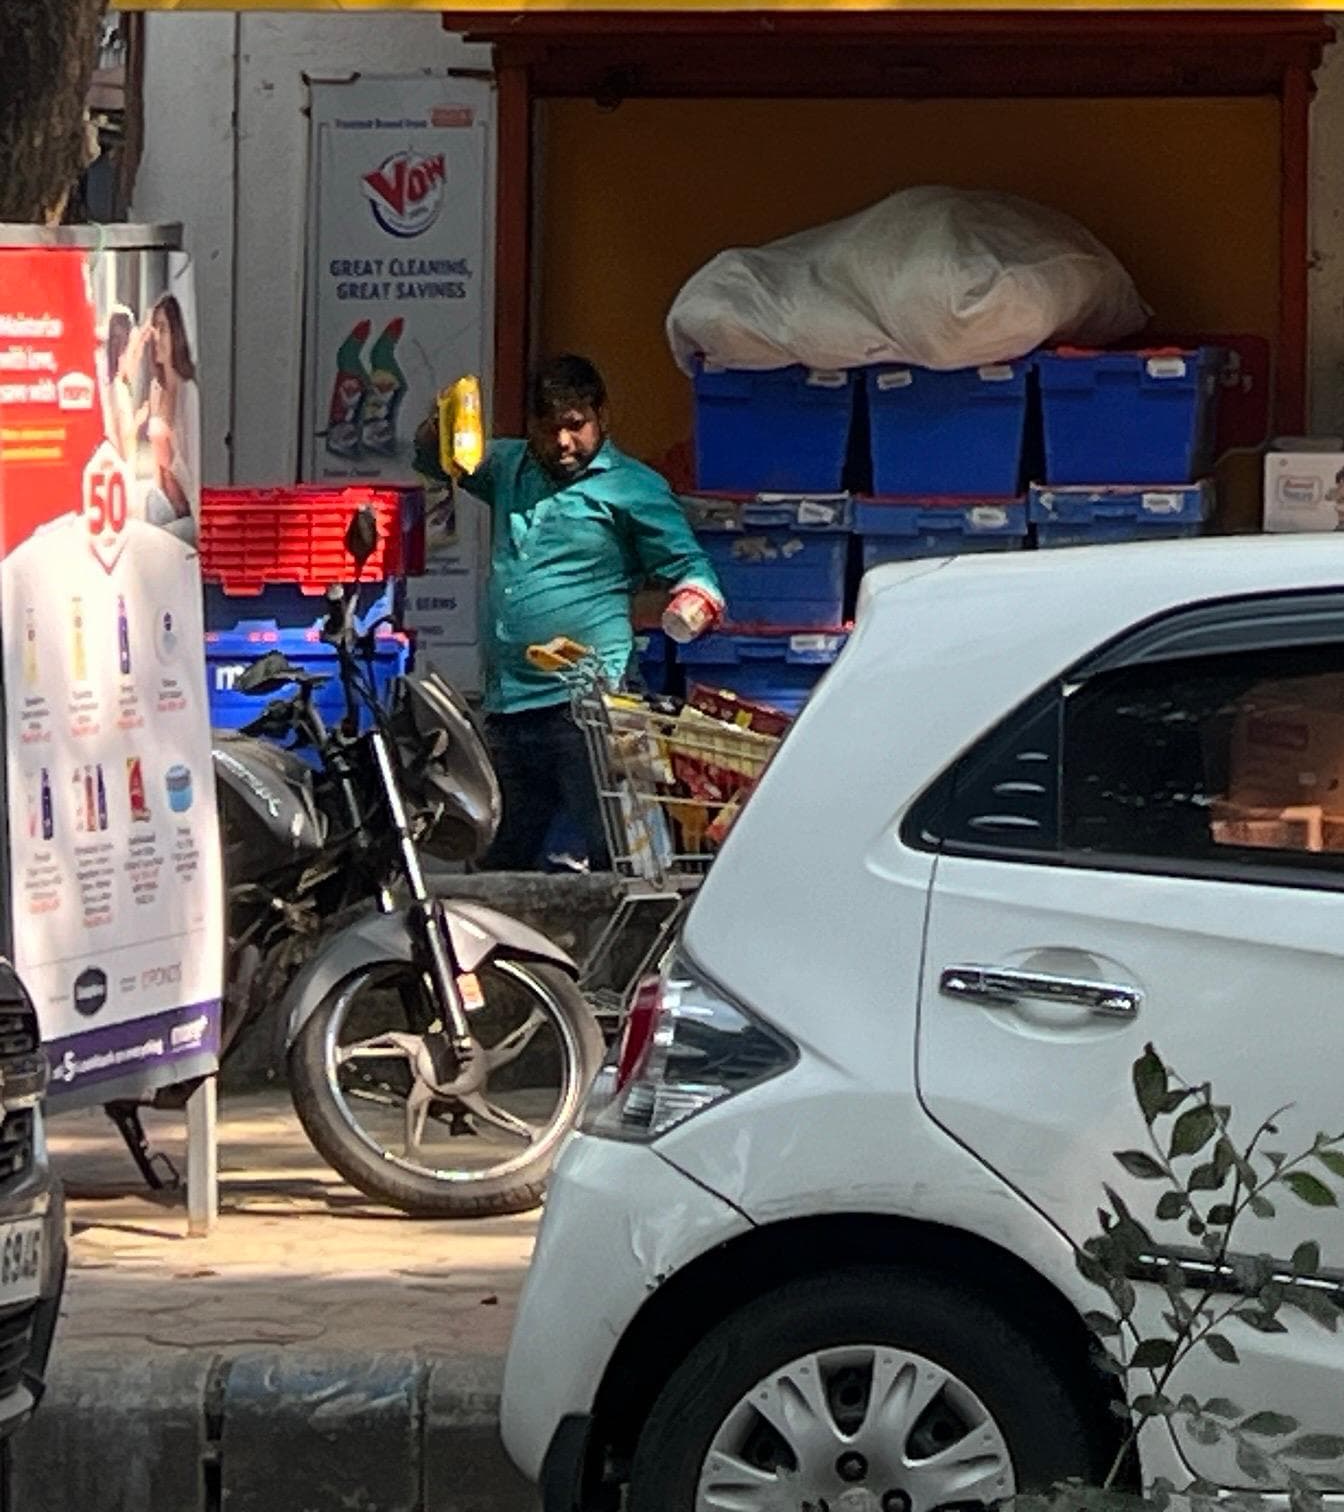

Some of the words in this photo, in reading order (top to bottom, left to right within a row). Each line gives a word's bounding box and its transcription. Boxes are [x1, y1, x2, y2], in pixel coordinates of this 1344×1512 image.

[328, 258, 384, 277] GREAT
[335, 282, 391, 300] GREAT
[87, 470, 127, 536] 50
